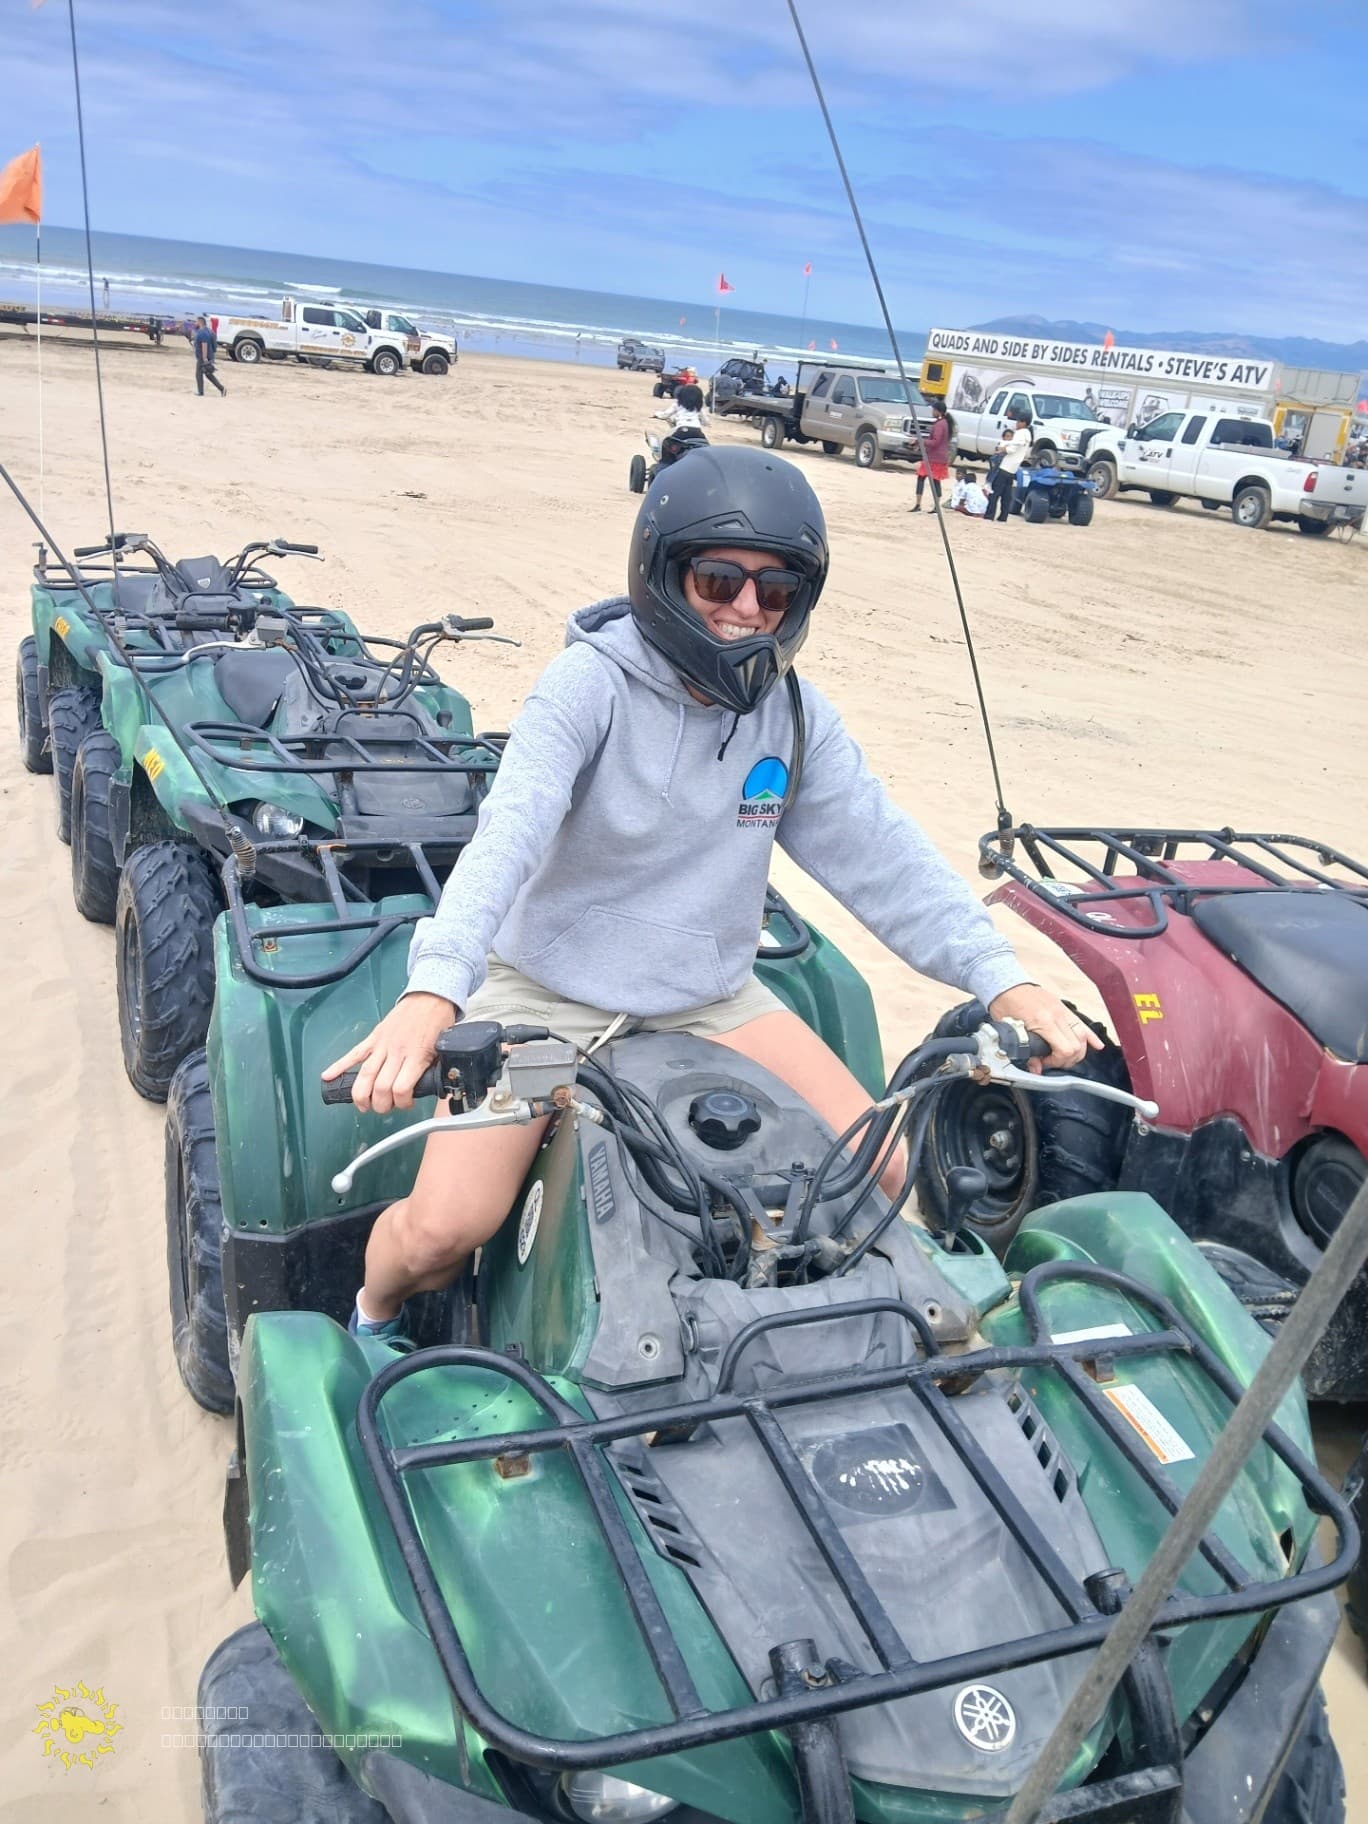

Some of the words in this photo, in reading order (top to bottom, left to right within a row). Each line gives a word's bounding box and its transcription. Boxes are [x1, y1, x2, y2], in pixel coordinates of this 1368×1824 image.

[932, 333, 971, 351] QUADS
[972, 338, 999, 354] AND
[1001, 341, 1029, 358] SIDE
[1031, 344, 1050, 360] BY
[1050, 346, 1088, 365] SIDES
[1091, 350, 1154, 372] RENTALS
[1164, 357, 1228, 381] STEVE'S
[1230, 365, 1268, 385] ATV
[738, 804, 758, 815] BIG
[759, 803, 782, 815] SKY
[590, 1146, 614, 1219] YAMAHA
